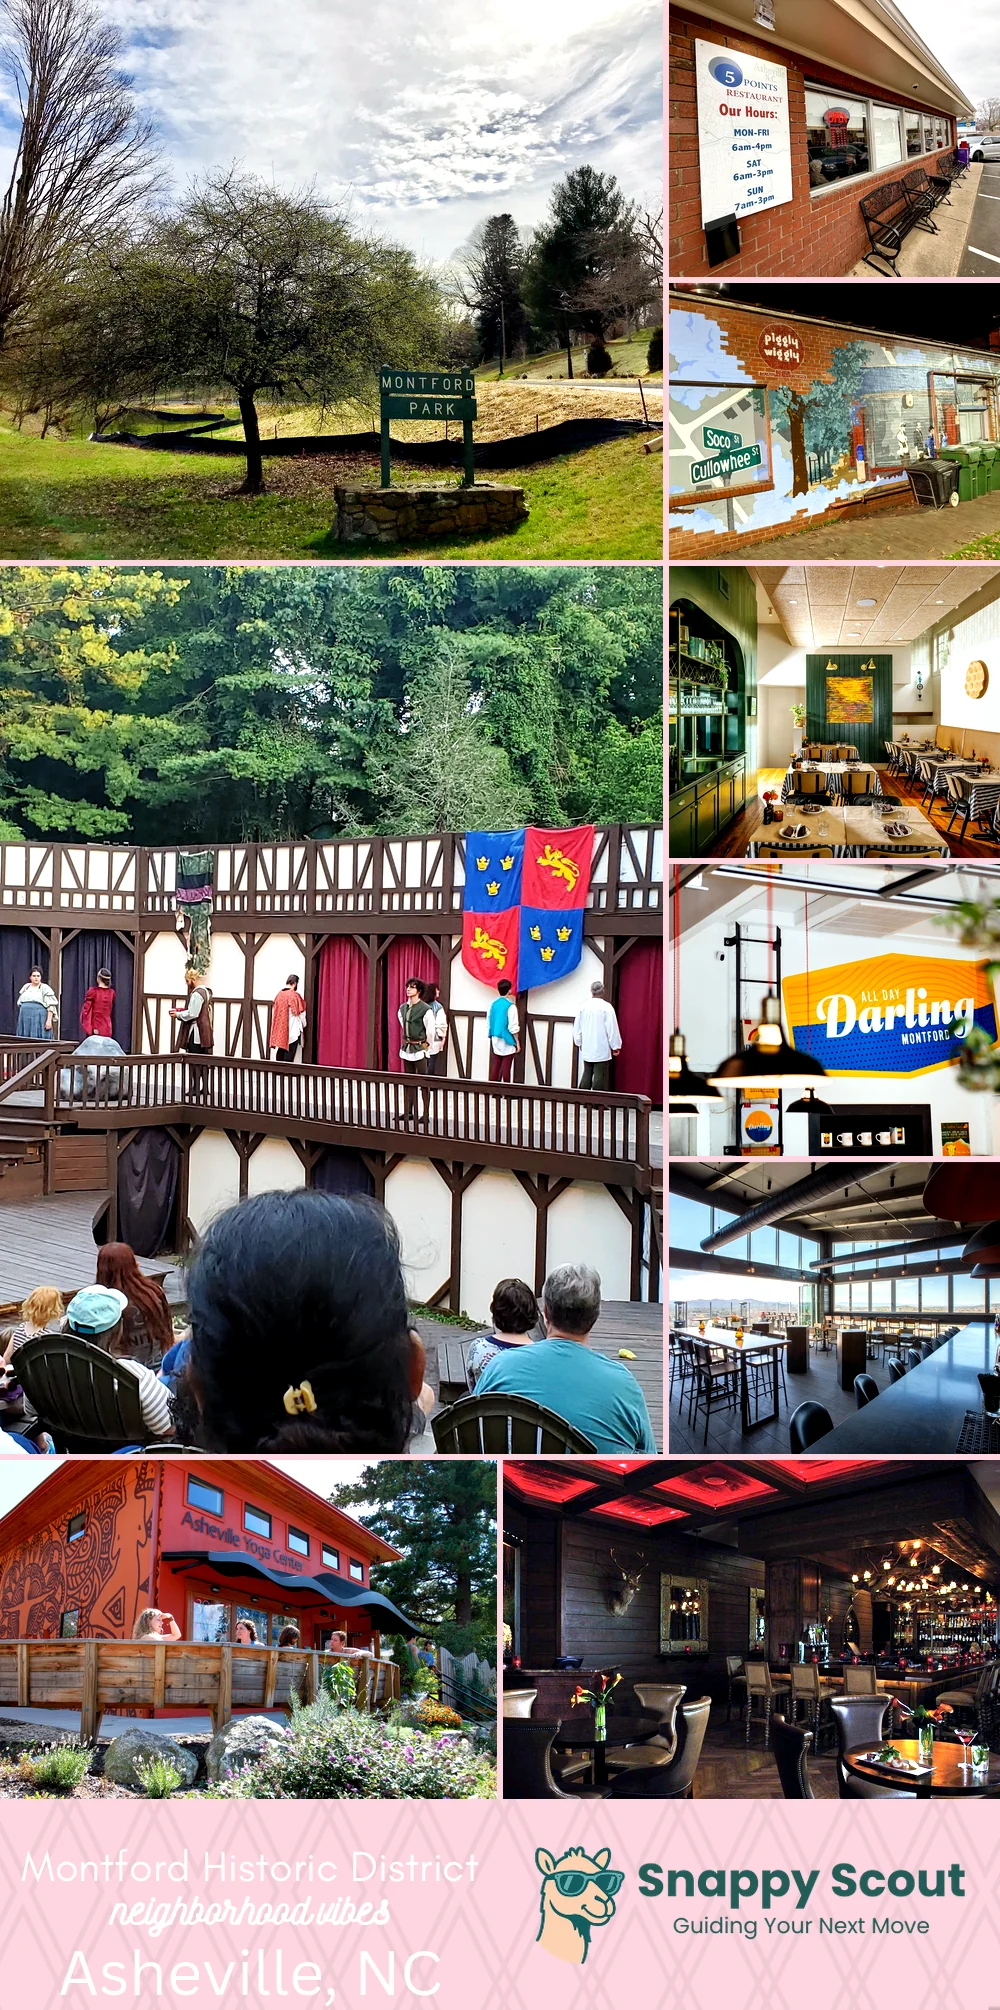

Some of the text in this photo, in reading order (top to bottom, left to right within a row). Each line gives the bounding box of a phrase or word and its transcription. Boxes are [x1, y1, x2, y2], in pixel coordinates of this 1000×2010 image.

[725, 70, 778, 92] 5 POINTS
[726, 89, 783, 103] RESTAURANT
[719, 103, 778, 119] Our Hours:
[733, 128, 769, 137] MON-FRI
[731, 142, 772, 152] 6am-4pm
[746, 159, 762, 168] SAT
[733, 168, 774, 181] 6am-3pm
[747, 186, 764, 197] SUN
[734, 194, 775, 211] 7am-3pm
[764, 332, 799, 349] piggly
[763, 347, 800, 363] wiggly
[382, 376, 474, 391] MONTFORD
[409, 402, 455, 415] PARK
[706, 429, 740, 449] Soco St
[692, 446, 759, 481] Cullowhee St
[861, 988, 901, 1003] ALL DAY
[816, 987, 975, 1039] Darling
[181, 1511, 304, 1572] Asheville Yoga Center
